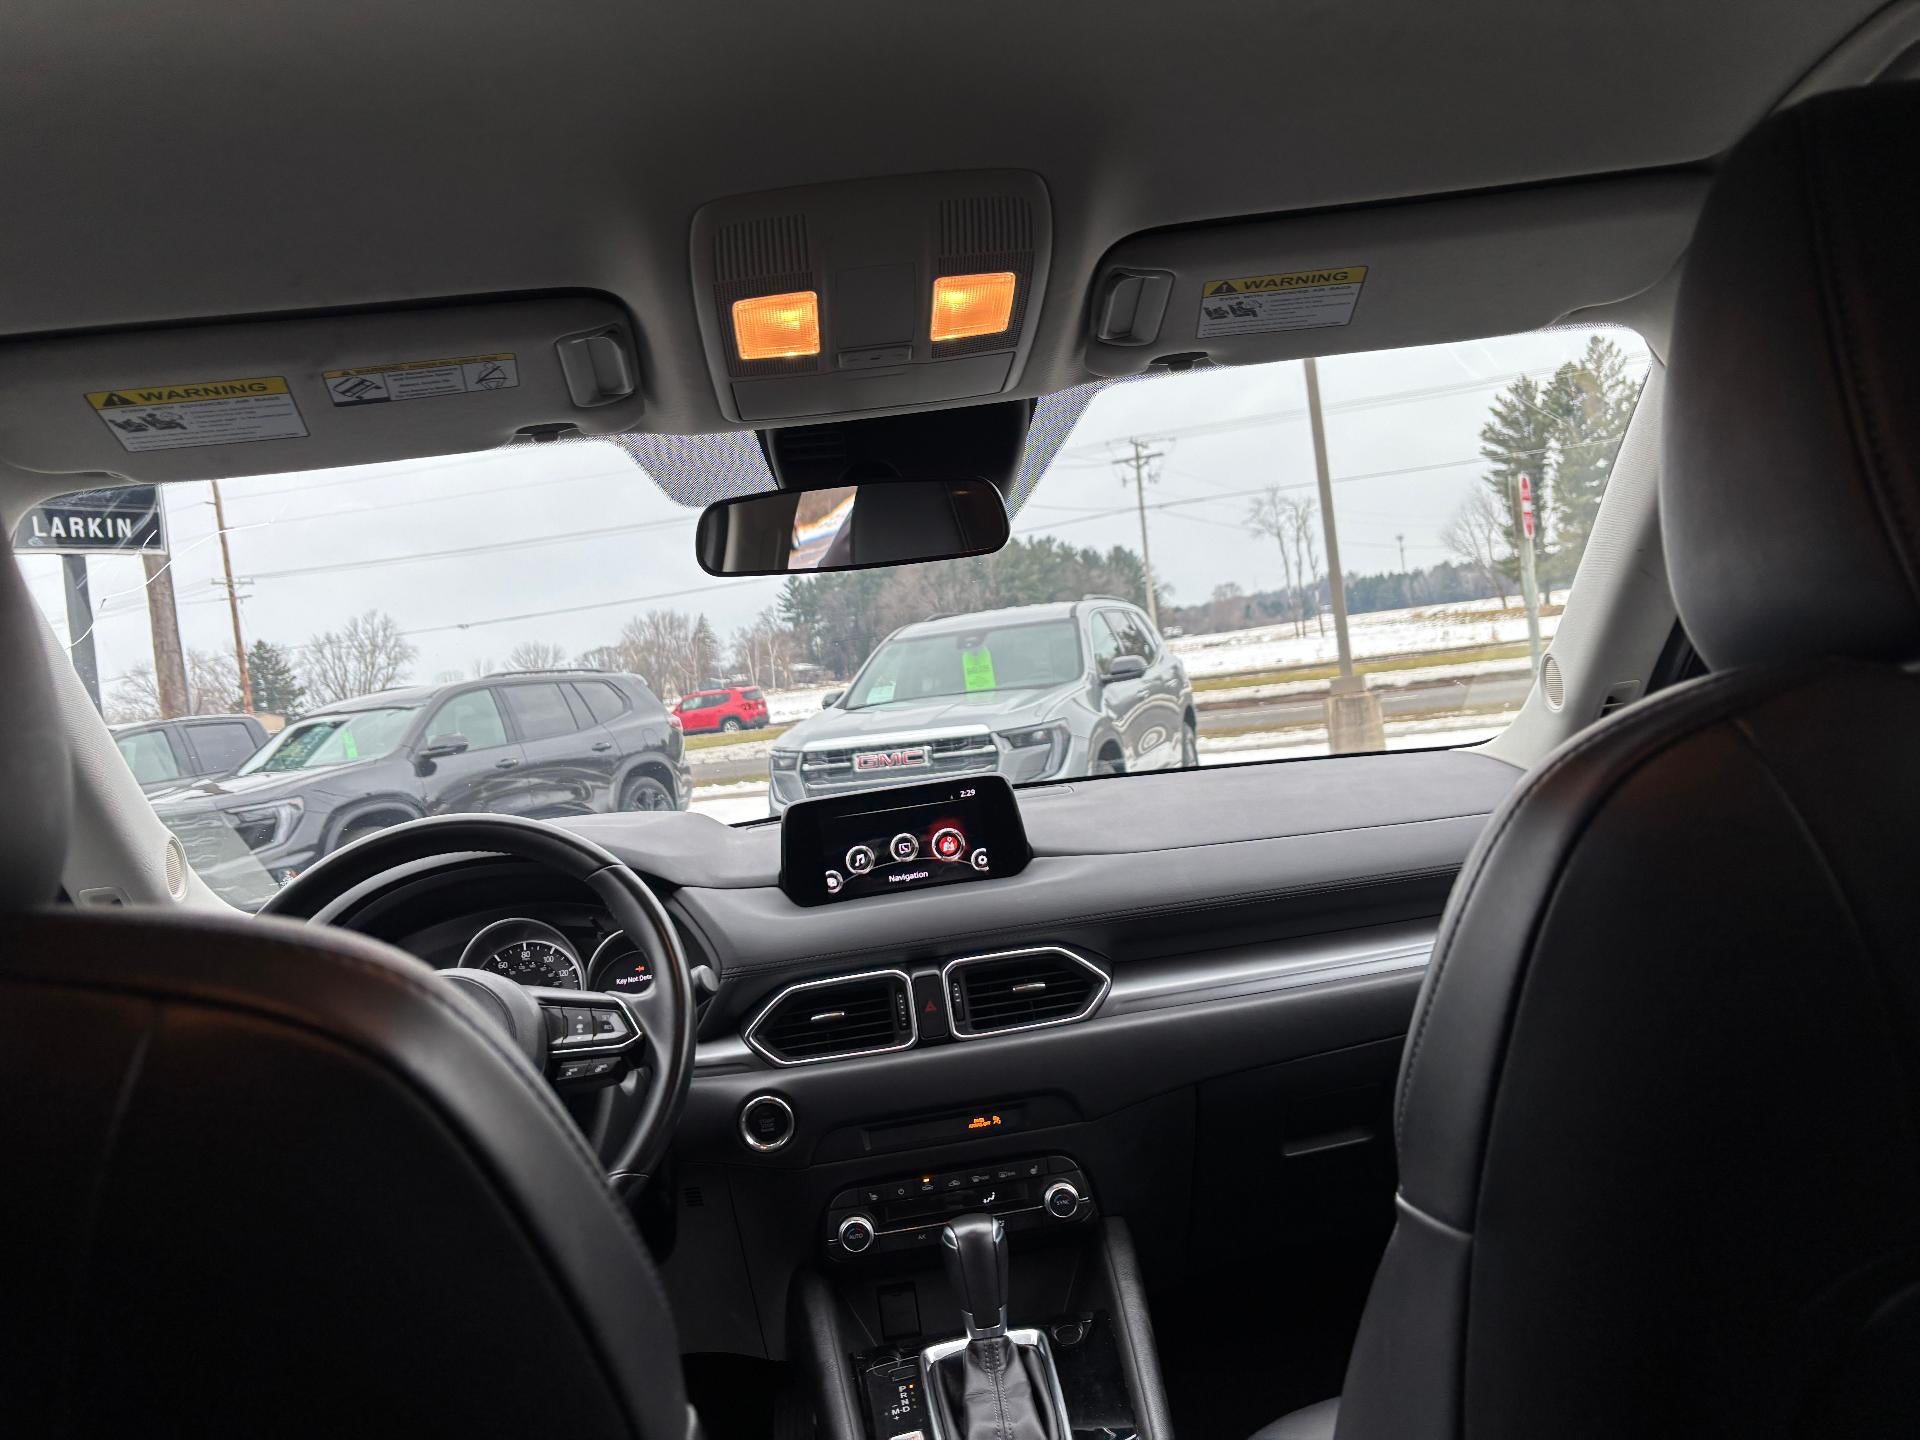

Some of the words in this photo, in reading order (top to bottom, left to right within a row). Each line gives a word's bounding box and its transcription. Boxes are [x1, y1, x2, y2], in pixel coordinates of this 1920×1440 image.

[1243, 271, 1349, 290] WARNING
[138, 382, 268, 402] WARNING
[31, 515, 132, 539] LARKIN
[856, 749, 924, 769] GMC
[960, 788, 976, 798] 2:29
[888, 870, 929, 883] Navigation
[520, 950, 531, 959] 80
[543, 955, 555, 964] 100
[558, 969, 569, 977] 120
[616, 978, 627, 986] Key
[901, 1398, 910, 1406] N
